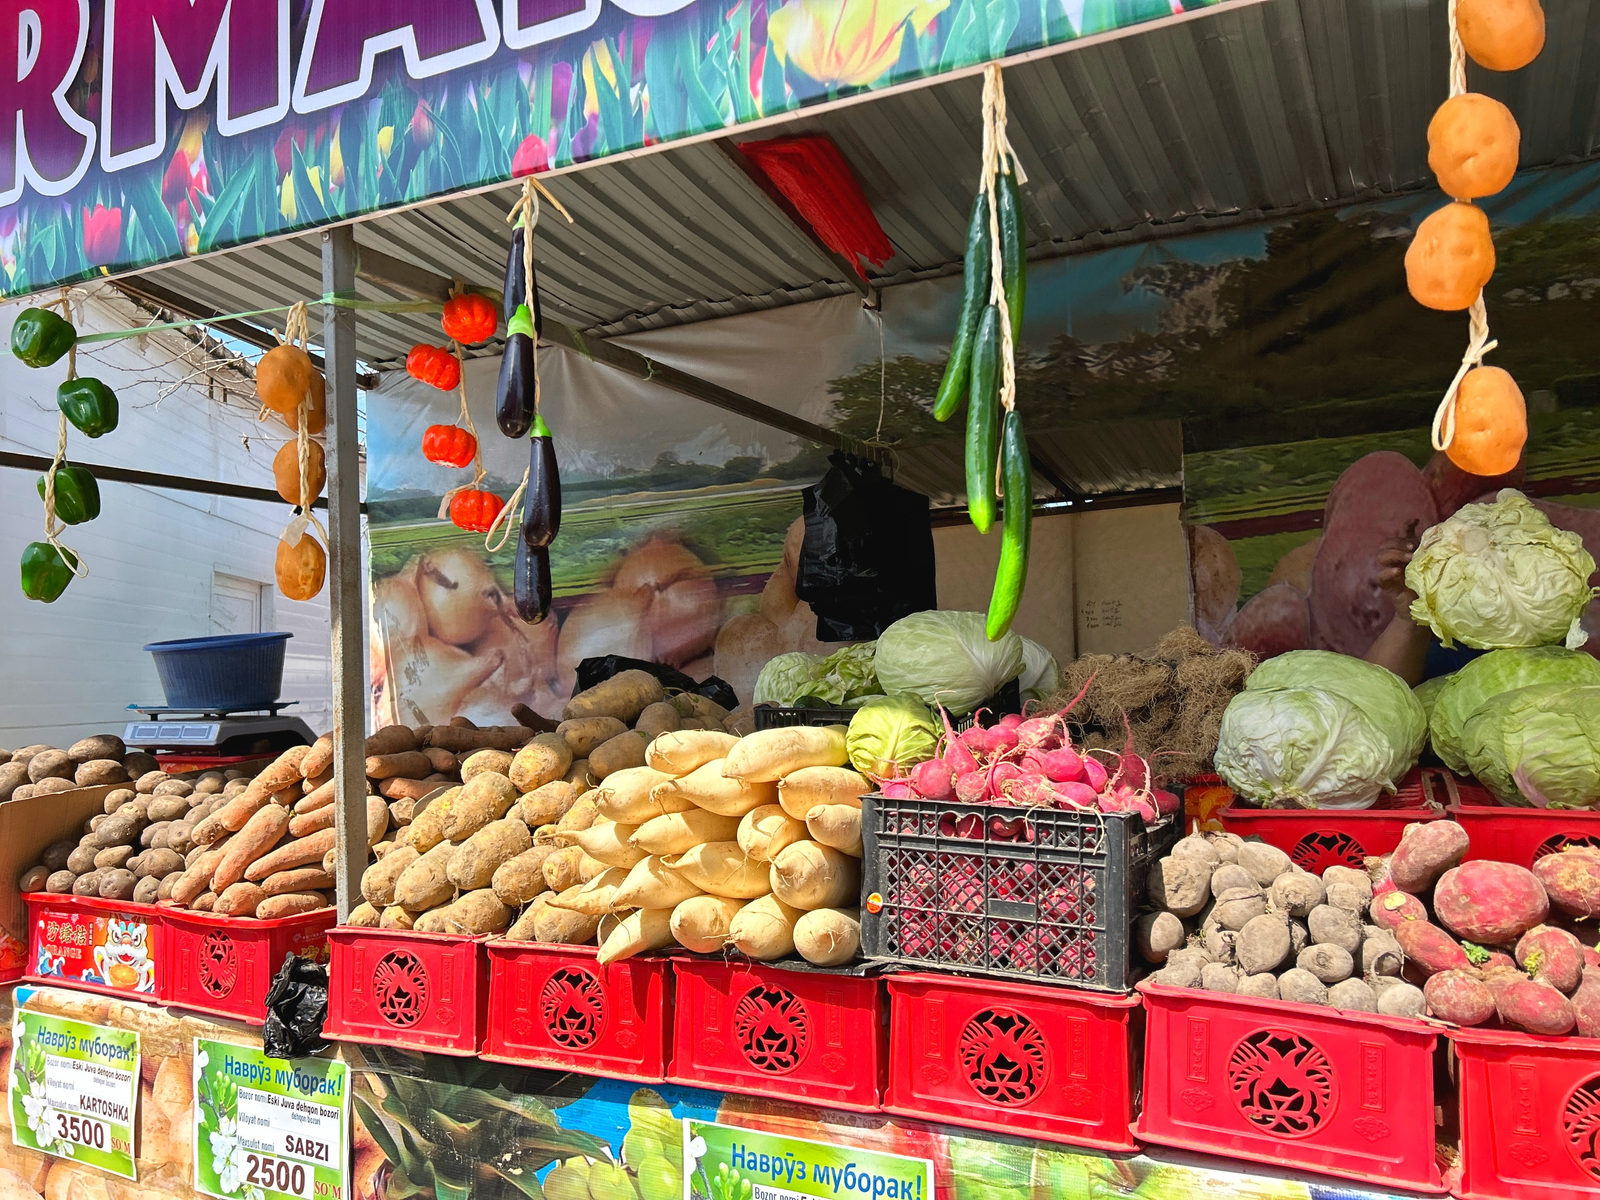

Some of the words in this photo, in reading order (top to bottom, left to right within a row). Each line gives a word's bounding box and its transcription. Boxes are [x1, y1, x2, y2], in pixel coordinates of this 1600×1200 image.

[45, 944, 82, 959] ORANGE
[79, 1036, 135, 1062] муборак!
[72, 1060, 84, 1071] Eski
[84, 1063, 97, 1074] Juva
[97, 1066, 115, 1079] dehqon
[115, 1070, 132, 1083] bozori
[275, 1067, 342, 1096] муборак!
[80, 1094, 129, 1123] KARTOSHKA
[267, 1094, 280, 1107] Eski
[280, 1098, 294, 1110] Juva
[295, 1101, 318, 1116] dehqon
[319, 1106, 339, 1120] bozori
[57, 1113, 104, 1149] 3500
[285, 1135, 329, 1162] SABZI
[246, 1154, 306, 1195] 2500
[813, 1163, 922, 1200] муборак!
